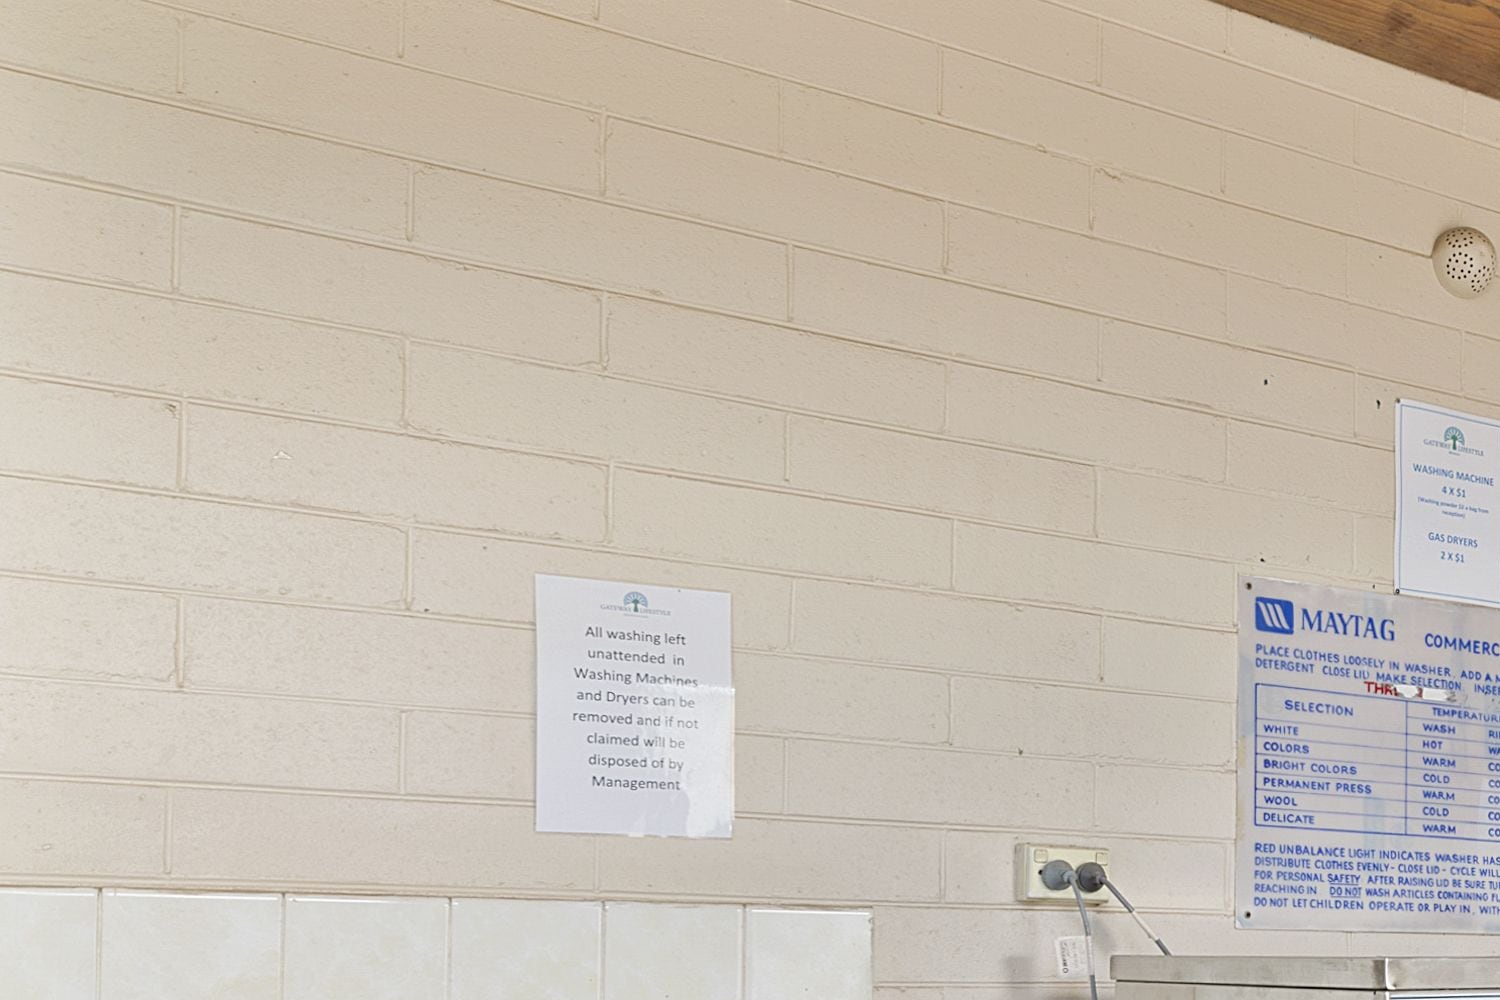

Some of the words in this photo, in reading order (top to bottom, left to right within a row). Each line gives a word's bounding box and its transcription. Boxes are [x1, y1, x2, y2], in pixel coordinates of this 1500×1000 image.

[1413, 464, 1454, 479] WASHING
[1456, 471, 1494, 486] MACHINE
[1442, 486, 1447, 494] 4
[1456, 488, 1466, 498] $1
[1428, 532, 1445, 542] GAS
[1447, 535, 1478, 547] DRYERS
[1441, 552, 1445, 560] 2
[1455, 554, 1464, 563] $1
[1301, 607, 1395, 641] MAYTAG
[585, 626, 602, 638] All
[607, 628, 661, 645] washing
[664, 632, 687, 646] left
[588, 648, 665, 666] unattended
[673, 655, 685, 666] in
[1256, 644, 1289, 657] PLACE
[1294, 649, 1340, 663] CLOTHES
[1344, 655, 1385, 668] LOOSELY
[1389, 661, 1400, 670] IN
[1461, 670, 1481, 680] ADD
[574, 667, 632, 685] Washing
[636, 673, 698, 687] Machines
[1256, 658, 1315, 674] DETERGENT
[1323, 666, 1350, 677] CLOSE
[1376, 673, 1407, 684] MAKE
[1410, 675, 1462, 691] SELECTION
[577, 690, 602, 702] and
[607, 692, 649, 706] Dryers
[653, 697, 675, 707] can
[680, 696, 695, 709] be
[1285, 700, 1353, 716] SELECTION
[573, 711, 633, 724] removed
[636, 715, 661, 727] and
[665, 716, 675, 728] if
[677, 719, 698, 729] not
[1423, 724, 1456, 734] WASH
[587, 733, 639, 746] claimed
[643, 736, 665, 748] will
[670, 738, 685, 749] be
[1264, 725, 1299, 735] WHITE
[1423, 741, 1442, 749] HOT
[588, 754, 647, 769] disposed
[651, 757, 665, 768] of
[669, 758, 684, 772] by
[1263, 742, 1310, 754] COLORS
[1423, 757, 1456, 767] WARM
[1264, 759, 1306, 771] BRIGHT
[1311, 763, 1357, 774] COLORS
[1423, 774, 1450, 783] COLD
[592, 776, 681, 792] Management
[1264, 777, 1331, 791] PERMANENT
[1336, 783, 1372, 794] PRESS
[1423, 790, 1455, 800] WARM
[1264, 795, 1298, 806] WOOL
[1423, 807, 1449, 816] COLD
[1263, 813, 1315, 824] DELICATE
[1423, 824, 1456, 834] WARM
[1255, 843, 1276, 853] RED
[1279, 845, 1345, 858] UNBALANCE
[1349, 848, 1375, 858] LIGHT
[1379, 850, 1430, 862] INDICATES
[1435, 854, 1479, 864] WASHER
[1255, 857, 1311, 869] DISTRIBUTE
[1315, 860, 1354, 870] CLOTHES
[1398, 864, 1423, 873] CLOSE
[1427, 866, 1440, 874] LID
[1450, 867, 1476, 876] CYCLE
[1480, 868, 1500, 878] WILL
[1255, 870, 1273, 880] FOR
[1277, 872, 1325, 882] PERSONAL
[1328, 874, 1360, 883] SAFETY
[1367, 876, 1395, 885] AFTER
[1398, 877, 1434, 887] RAISING
[1436, 879, 1449, 887] LID
[1452, 880, 1462, 888] BE
[1465, 880, 1485, 889] SURE
[1255, 883, 1304, 894] REACHING
[1307, 886, 1317, 894] IN
[1330, 887, 1343, 895] DO
[1345, 887, 1361, 896] NOT
[1366, 889, 1390, 897] WASH
[1393, 889, 1434, 899] ARTICLES
[1438, 891, 1488, 901] CONTAINING
[1254, 897, 1267, 907] DO
[1270, 898, 1289, 907] NOT
[1293, 899, 1307, 908] LET
[1310, 900, 1363, 910] CHILDREN
[1369, 902, 1414, 911] OPERATE
[1418, 903, 1430, 912] OR
[1434, 904, 1456, 912] PLAY
